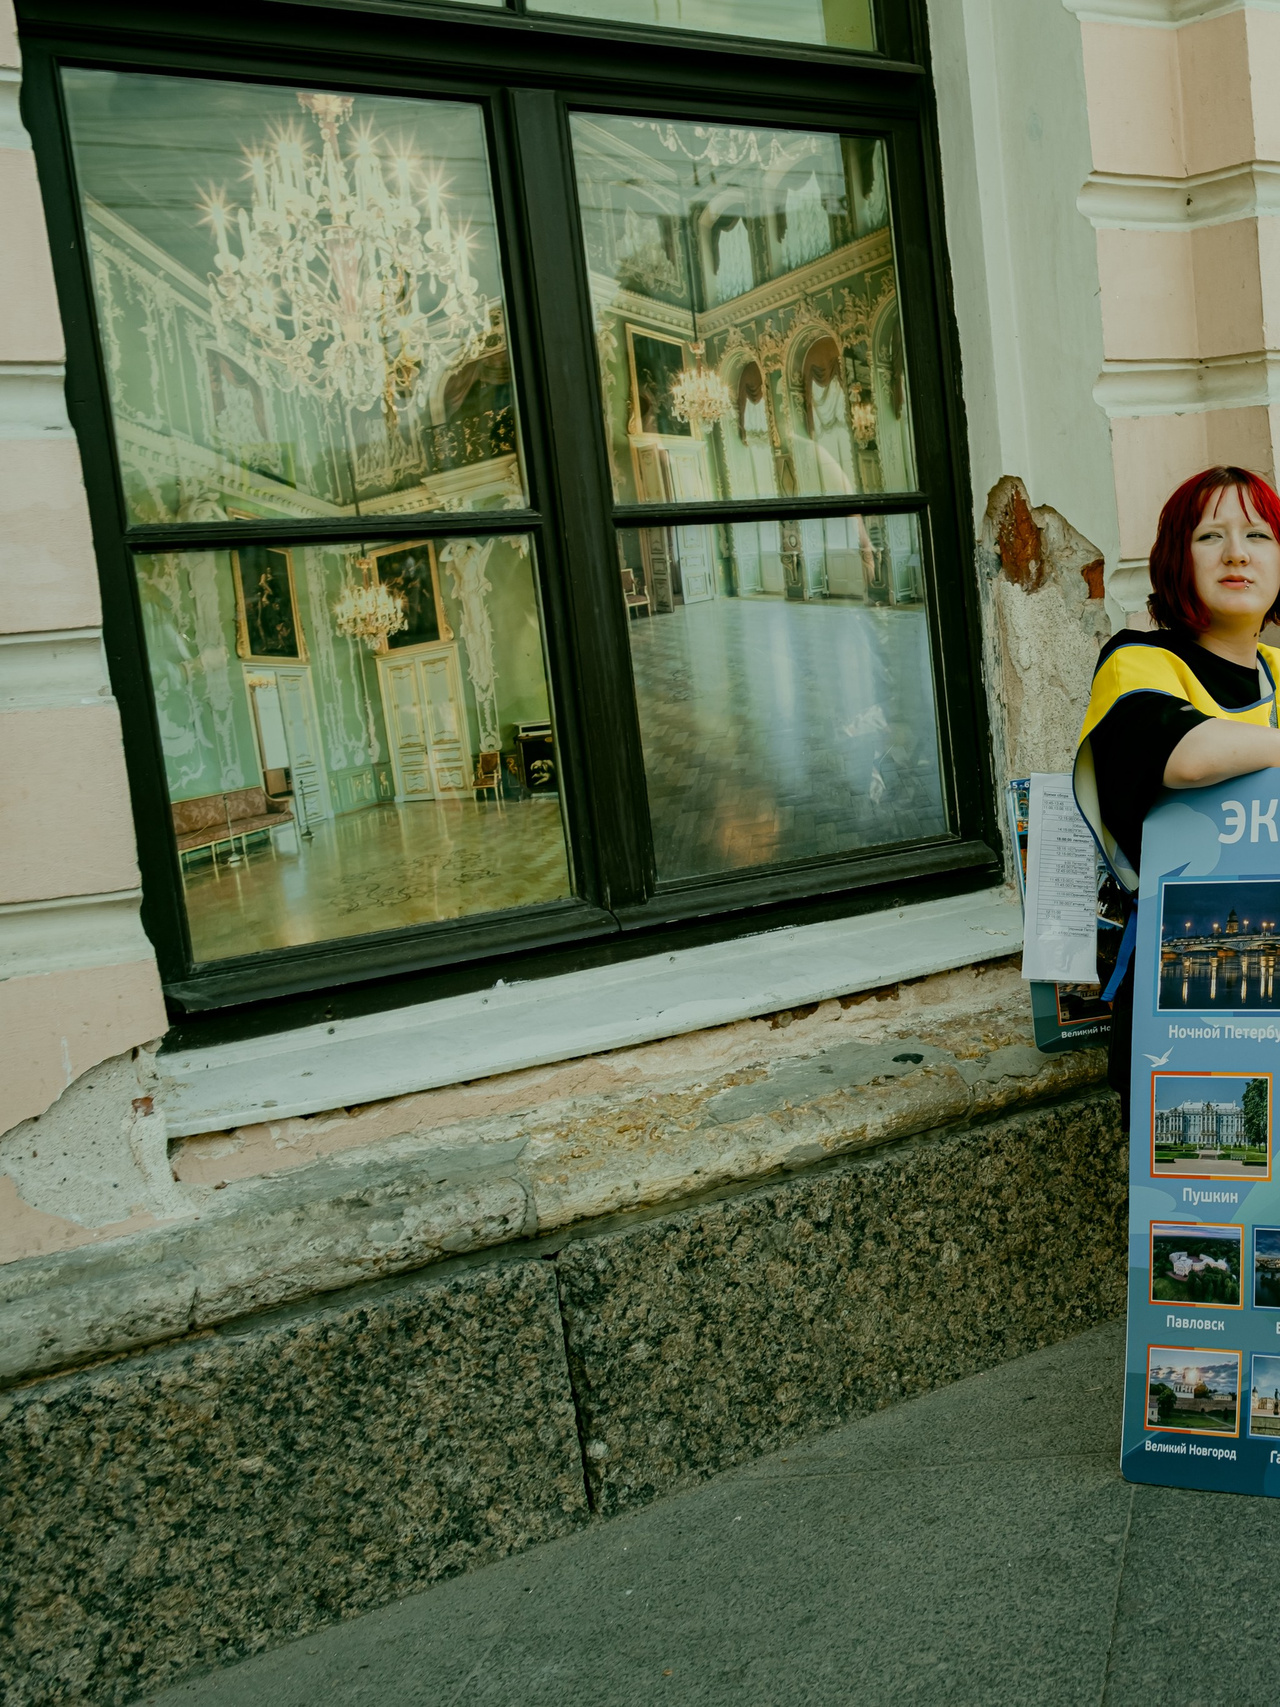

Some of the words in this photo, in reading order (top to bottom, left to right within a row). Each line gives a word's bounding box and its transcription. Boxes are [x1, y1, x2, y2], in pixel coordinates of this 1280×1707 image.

[1061, 1027, 1099, 1039] Великий
[1169, 1024, 1220, 1038] Ночной
[1183, 1188, 1237, 1205] Пушкин
[1167, 1315, 1224, 1330] Павловск
[1145, 1440, 1186, 1454] Великий
[1189, 1444, 1236, 1460] Новгород
